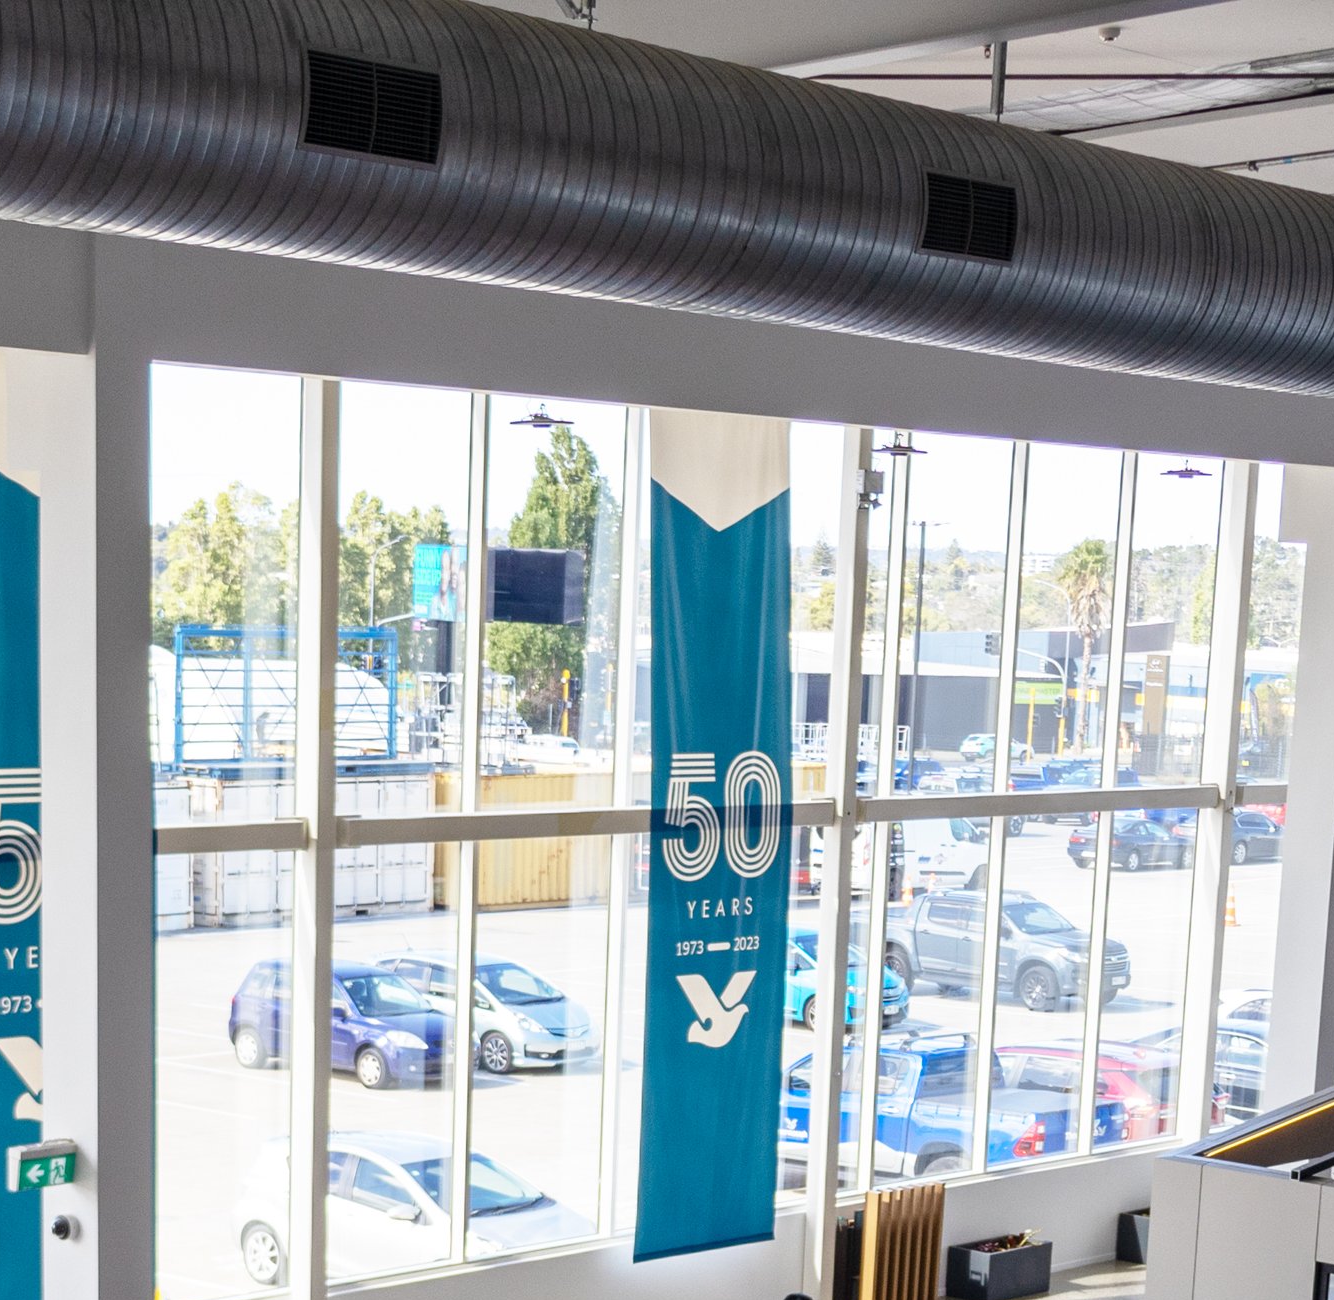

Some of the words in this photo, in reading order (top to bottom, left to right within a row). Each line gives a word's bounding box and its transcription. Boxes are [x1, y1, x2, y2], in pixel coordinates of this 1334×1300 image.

[662, 750, 782, 882] 50
[687, 897, 753, 919] YEARS
[676, 940, 704, 957] 1973
[733, 935, 760, 952] 2023
